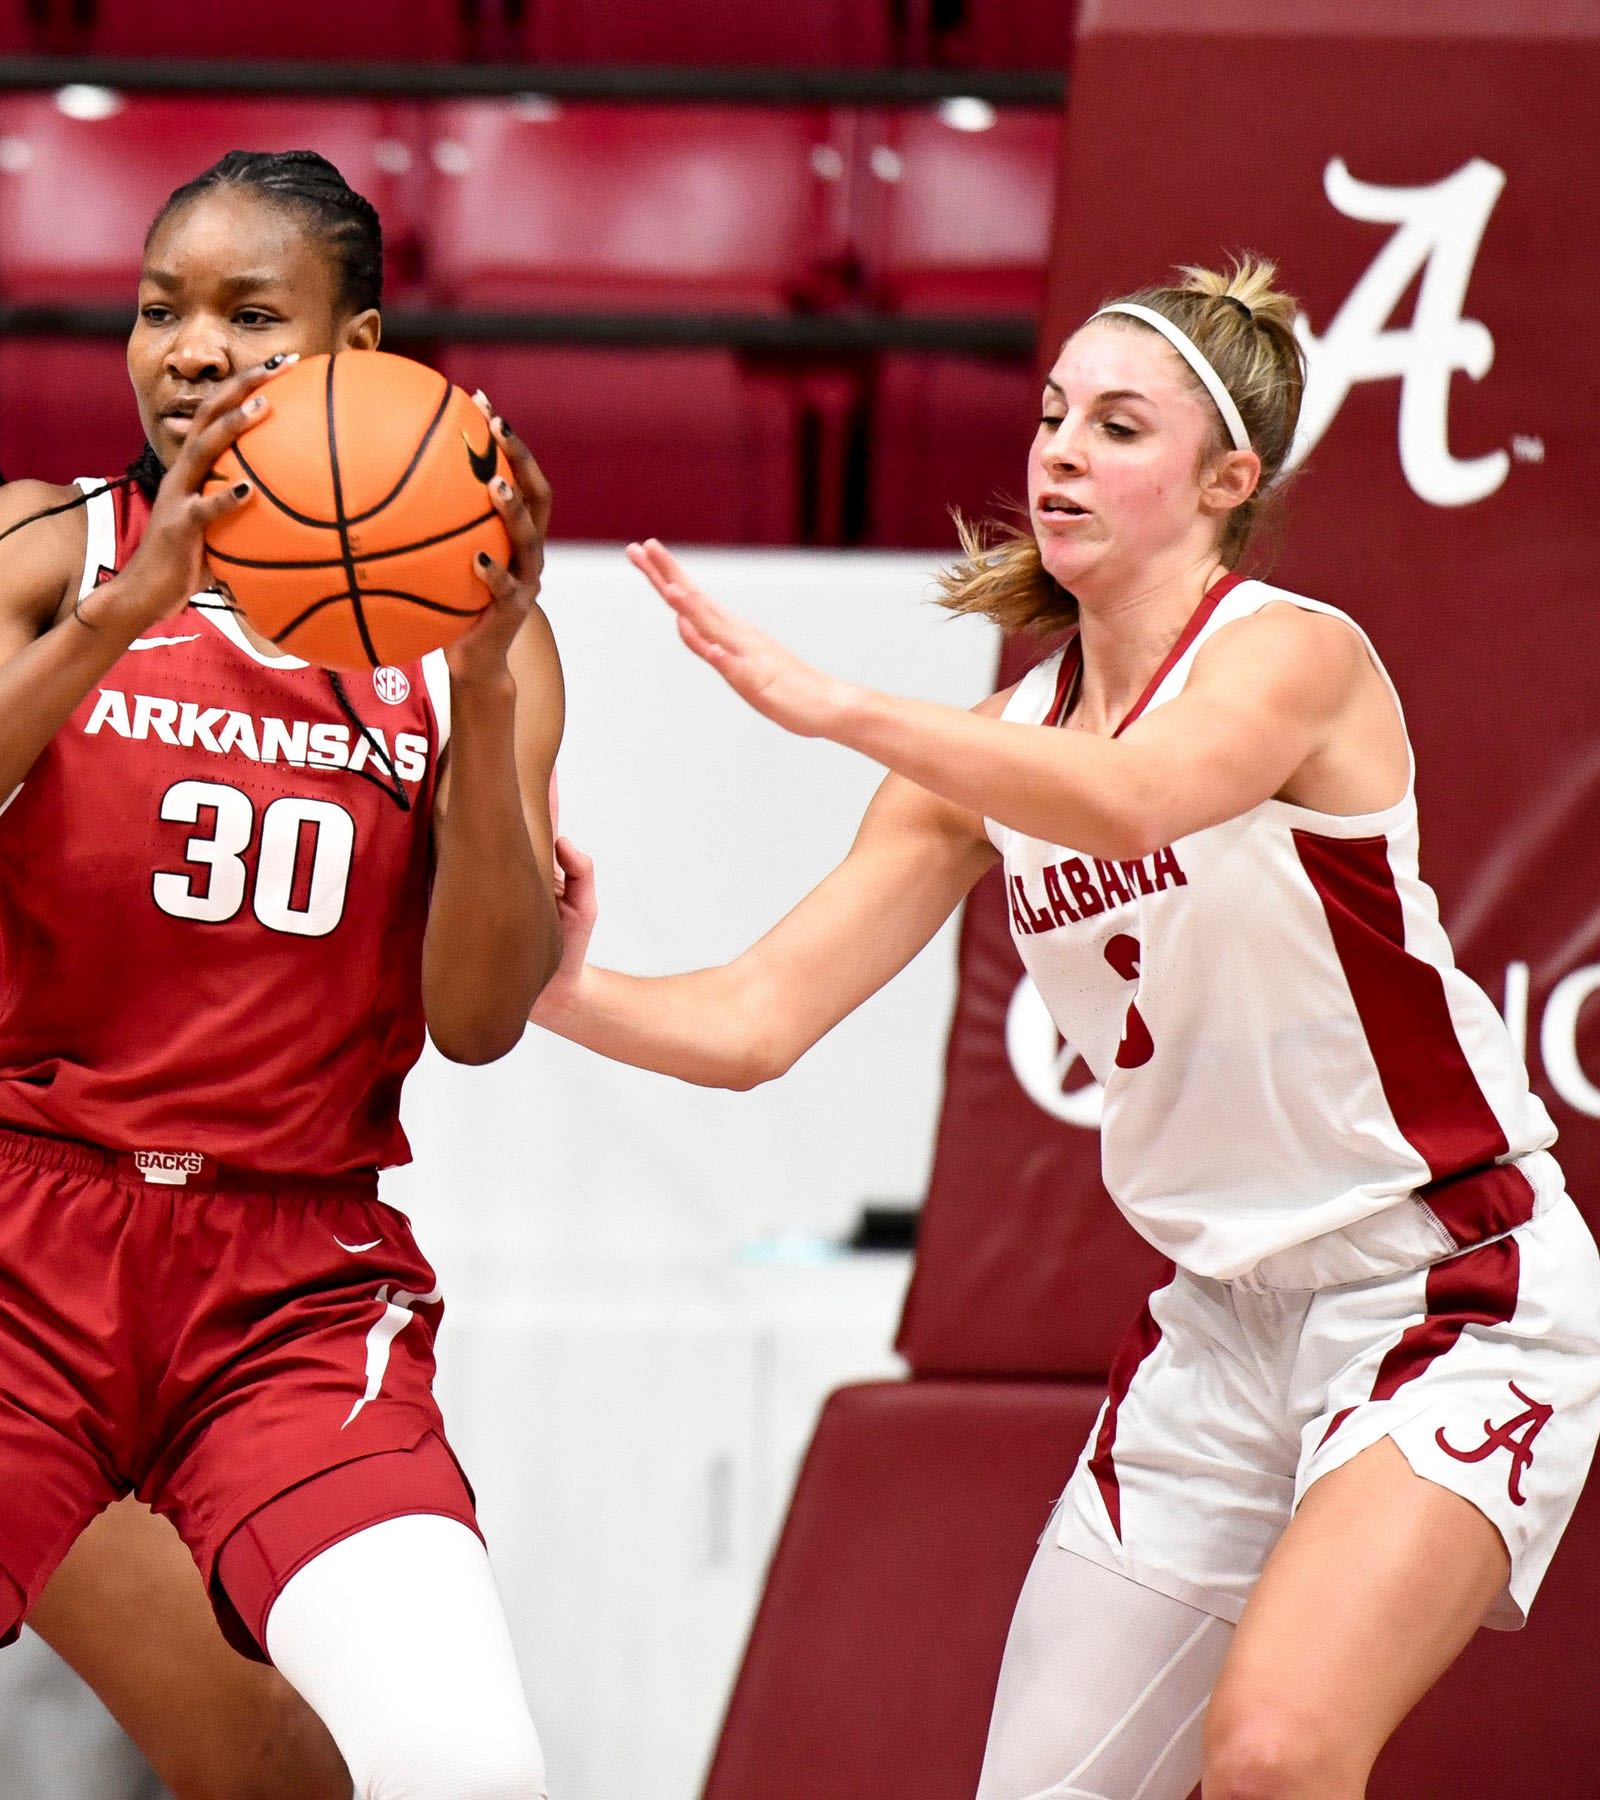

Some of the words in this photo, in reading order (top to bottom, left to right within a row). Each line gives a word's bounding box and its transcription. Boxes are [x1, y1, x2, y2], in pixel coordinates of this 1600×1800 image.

[376, 667, 407, 702] SEC
[84, 688, 428, 782] ARKANSAS
[152, 779, 356, 939] 30
[137, 1153, 201, 1173] BACKS
